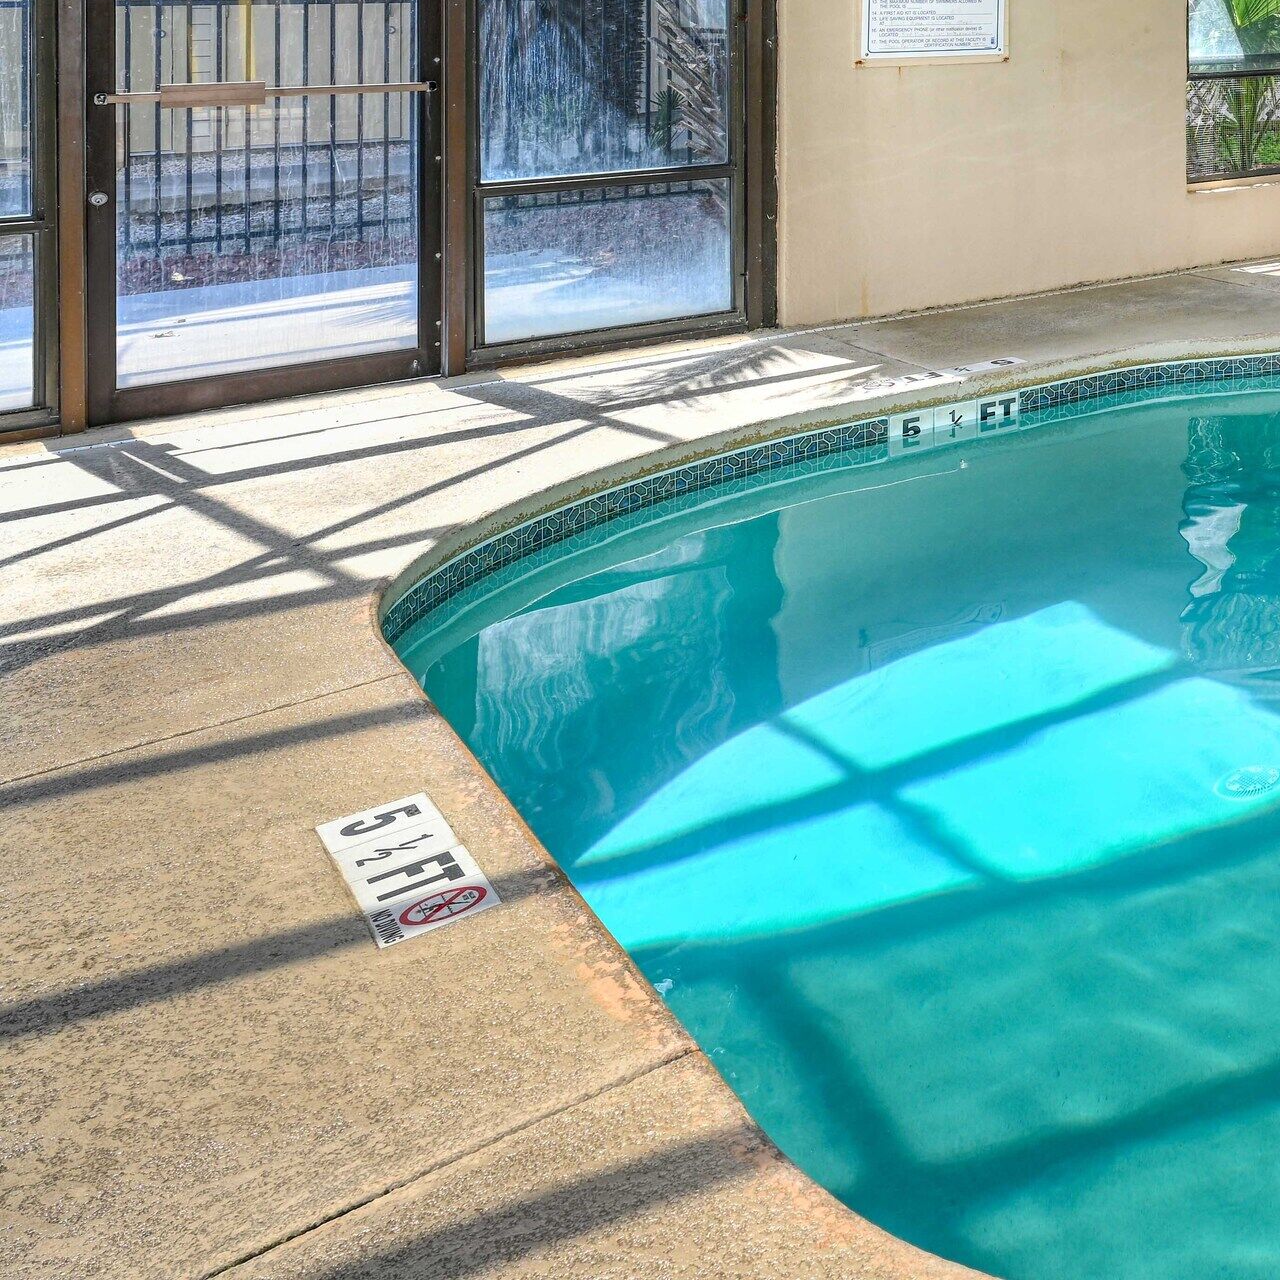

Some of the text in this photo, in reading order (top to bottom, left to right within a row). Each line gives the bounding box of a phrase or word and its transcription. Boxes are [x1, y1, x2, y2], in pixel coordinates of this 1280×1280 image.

[902, 417, 921, 437] 5
[980, 398, 1016, 421] FT
[340, 804, 421, 836] 5
[366, 851, 465, 902] FT
[370, 908, 405, 944] NO DIVING
